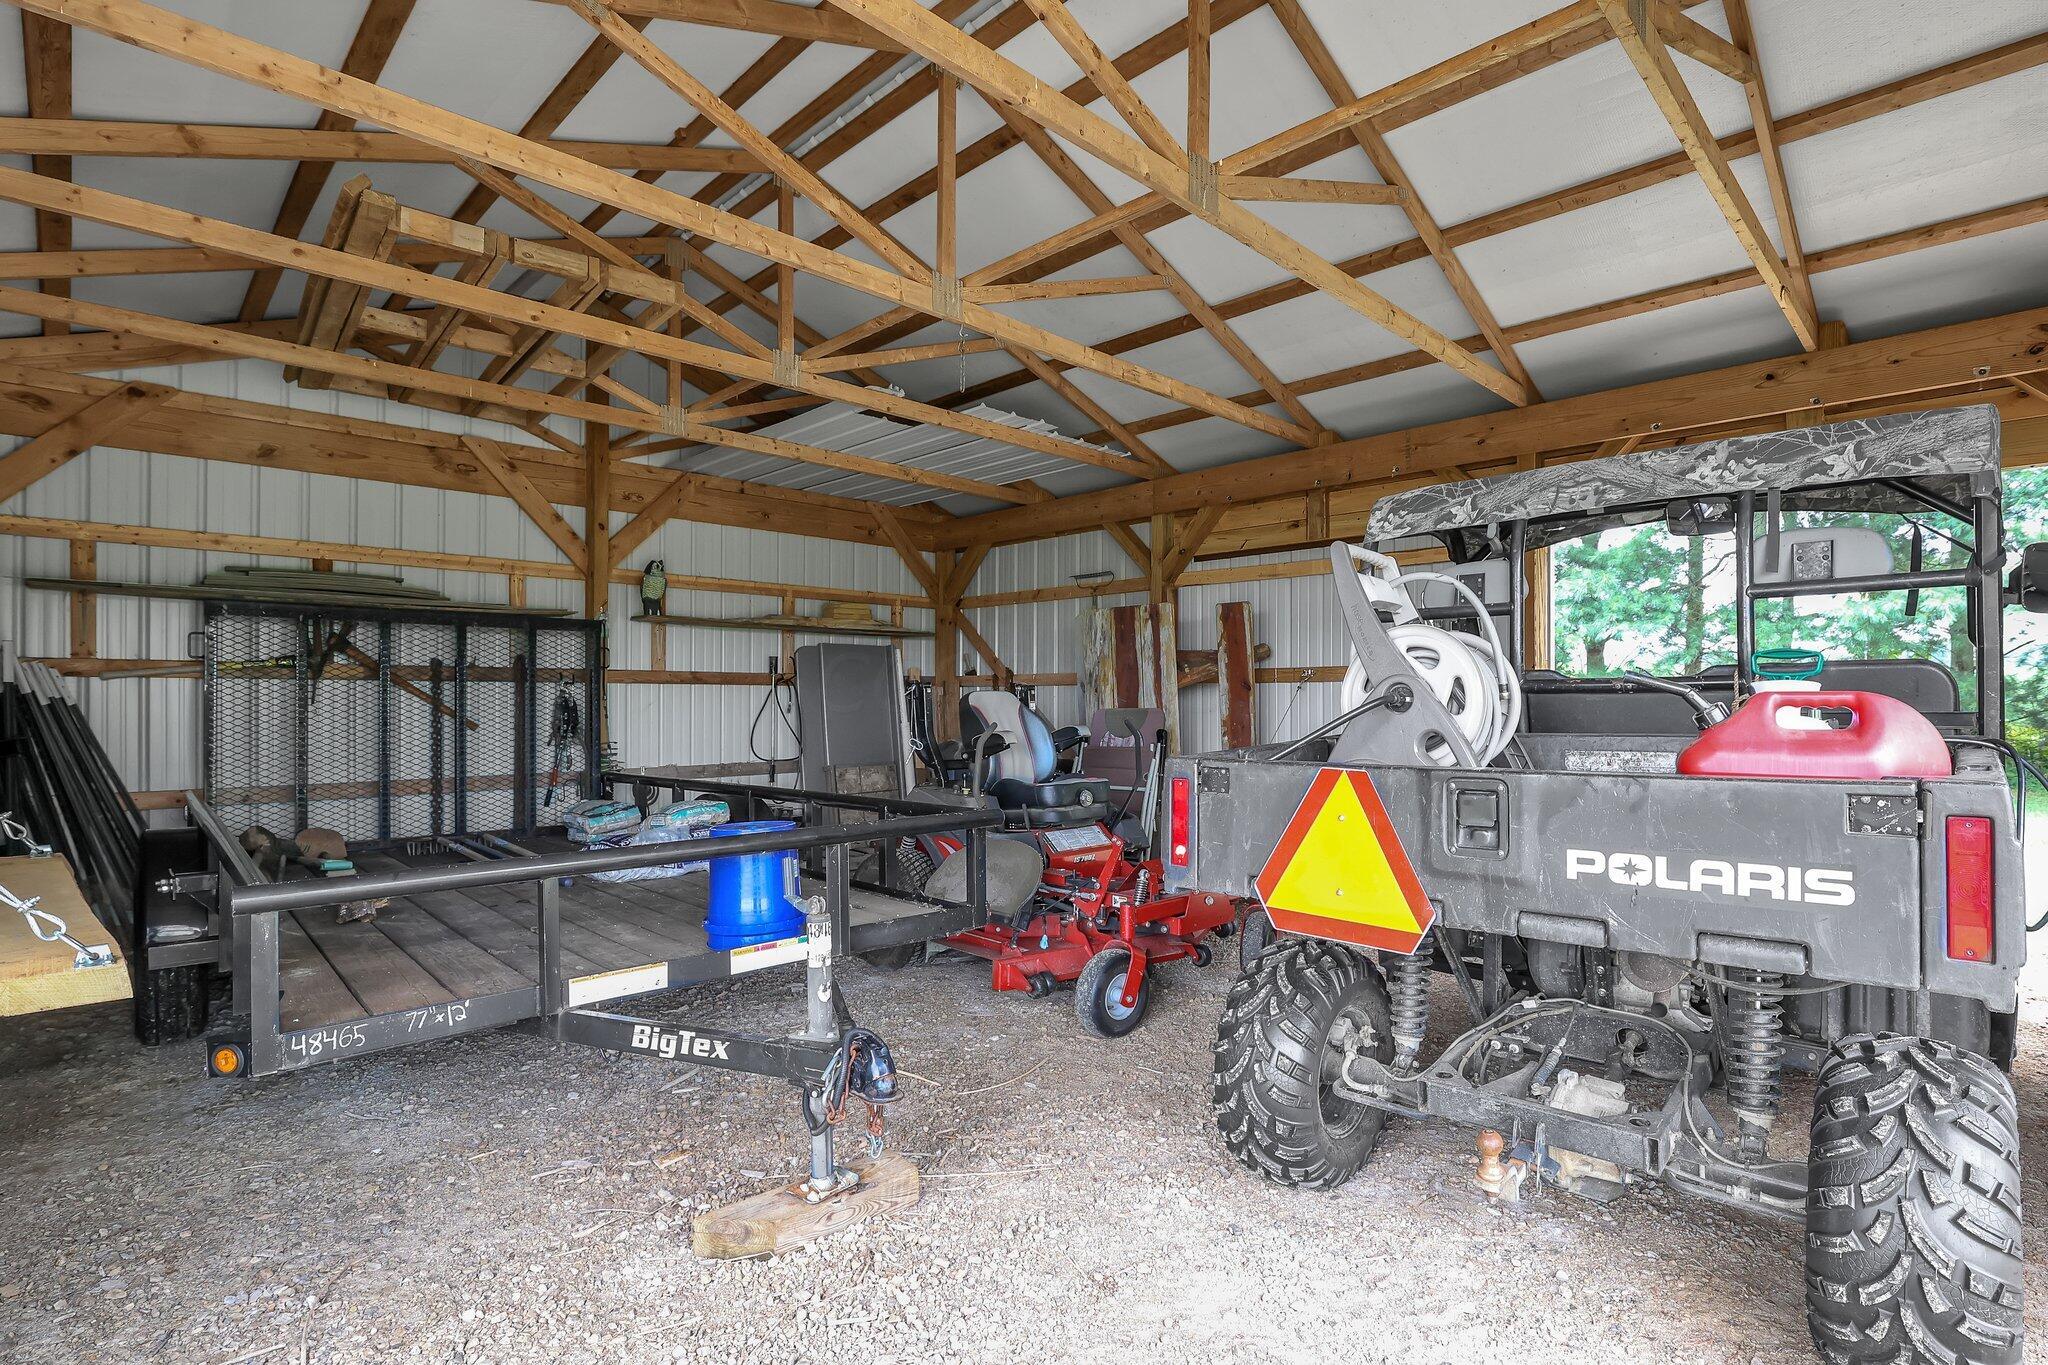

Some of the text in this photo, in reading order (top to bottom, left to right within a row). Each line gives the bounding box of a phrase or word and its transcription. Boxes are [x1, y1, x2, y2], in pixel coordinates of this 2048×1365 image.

[1566, 849, 1856, 906] POLARIS
[291, 1024, 369, 1056] 48465
[631, 1024, 731, 1060] BigTex
